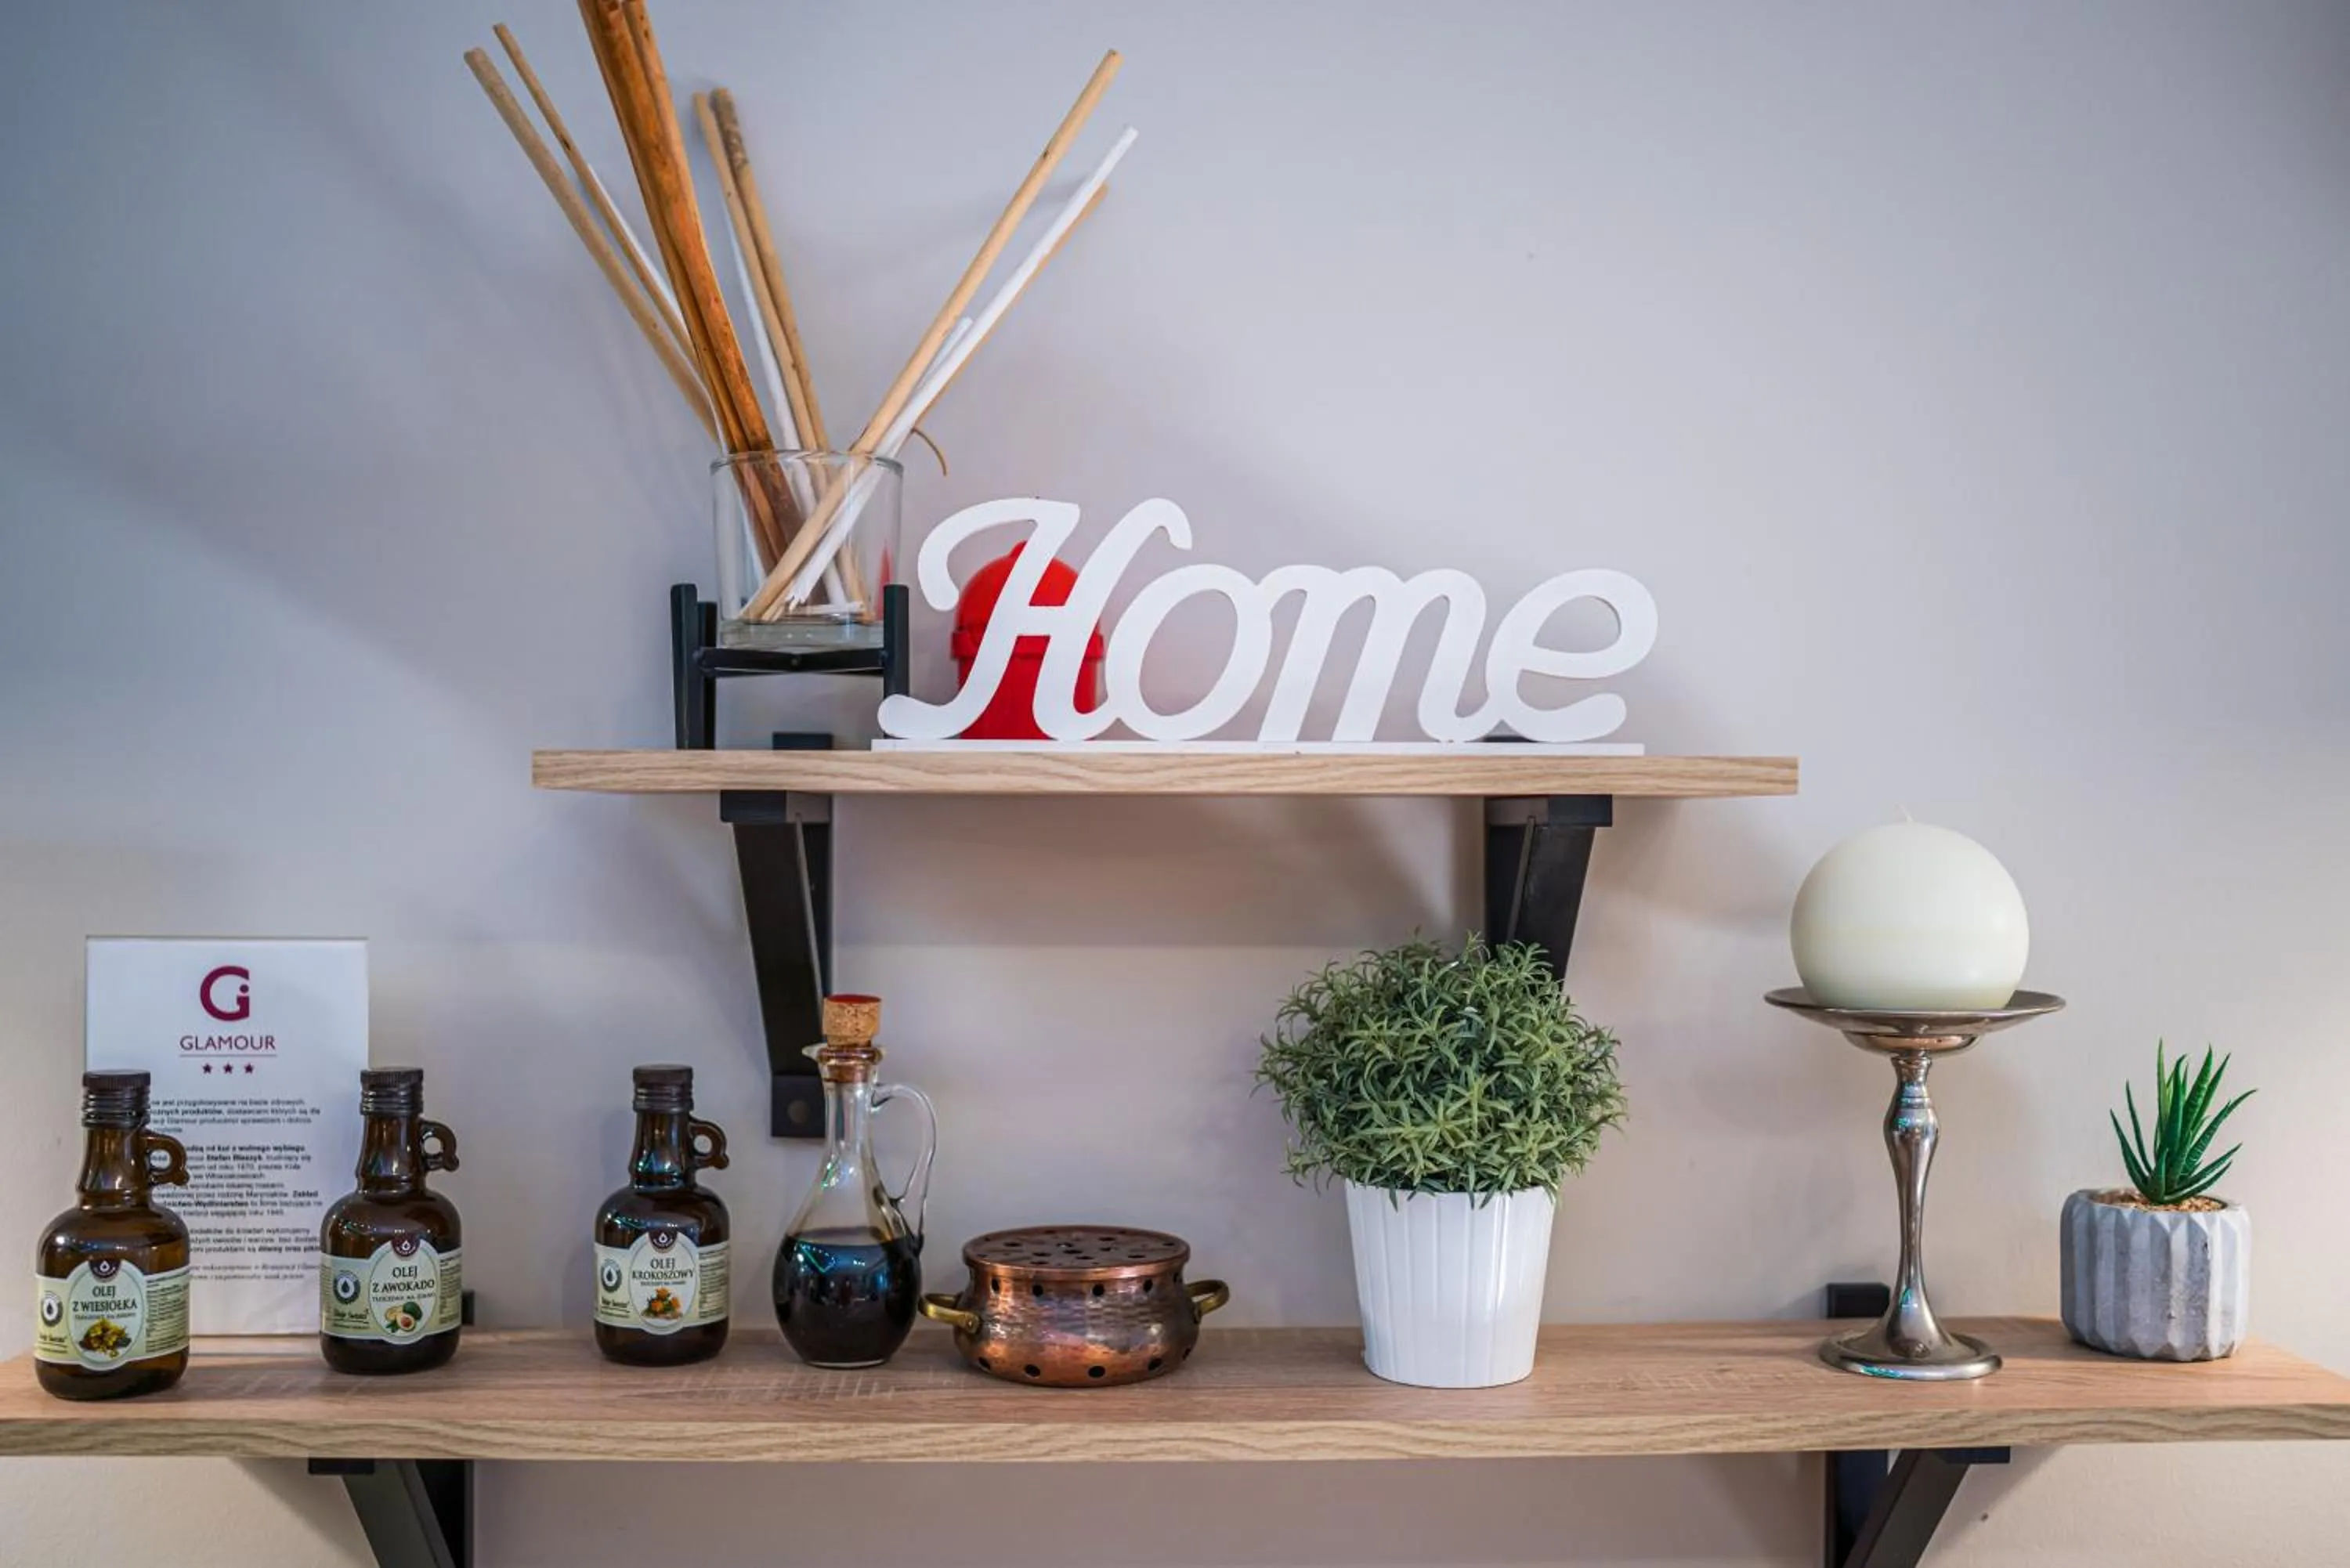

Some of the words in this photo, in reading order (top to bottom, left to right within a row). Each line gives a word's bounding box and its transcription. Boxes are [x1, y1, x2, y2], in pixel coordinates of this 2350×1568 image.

[877, 497, 1658, 742] Home
[179, 1035, 276, 1051] GLAMOUR
[650, 1257, 676, 1270] OLEJ
[392, 1266, 418, 1278] OLEJ
[92, 1285, 117, 1298] OLEJ
[372, 1281, 379, 1293] Z
[381, 1279, 435, 1293] AWOKADO
[72, 1301, 79, 1313] Z
[80, 1298, 138, 1312] WIESIOŁKA
